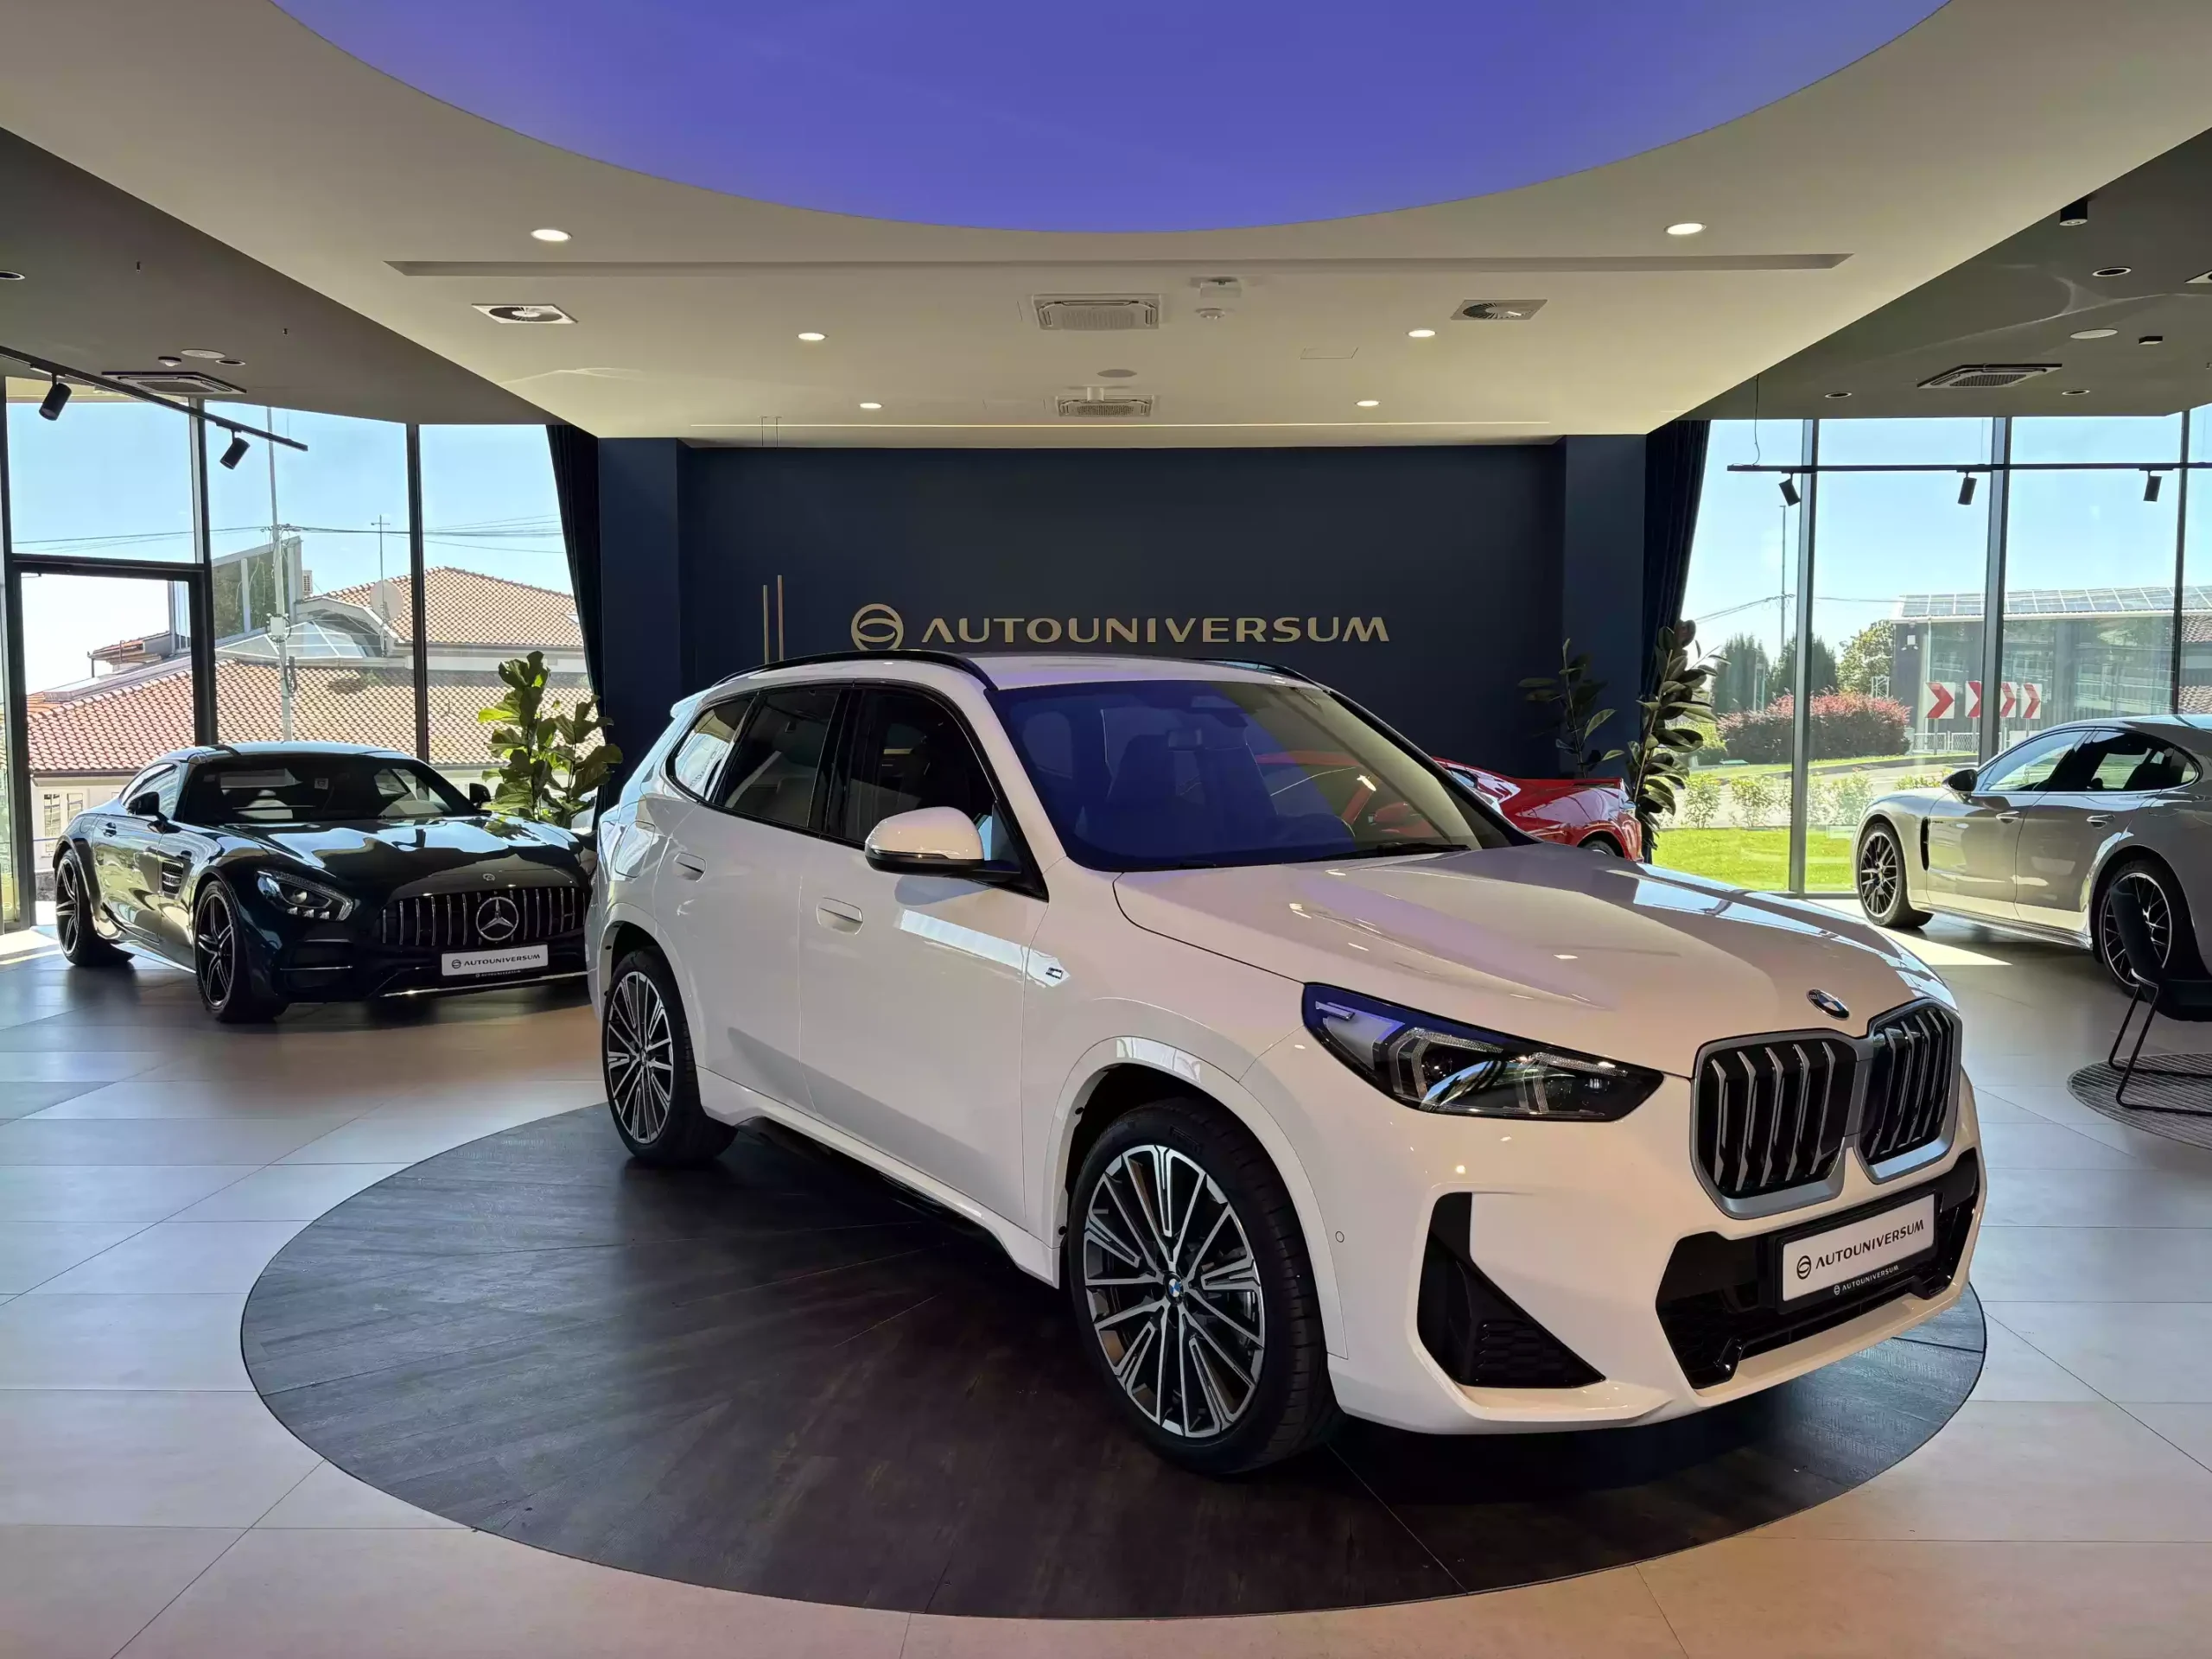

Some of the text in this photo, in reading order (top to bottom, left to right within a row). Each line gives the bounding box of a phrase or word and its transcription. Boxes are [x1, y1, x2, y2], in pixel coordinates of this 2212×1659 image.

[922, 616, 1390, 644] AUTOUNIVERSUM
[463, 954, 541, 966] AUTOUNIVERSUM
[1815, 1219, 1924, 1270] AUTOUNIVERSUM
[1841, 1264, 1900, 1291] AUTOUNIVERSUM
